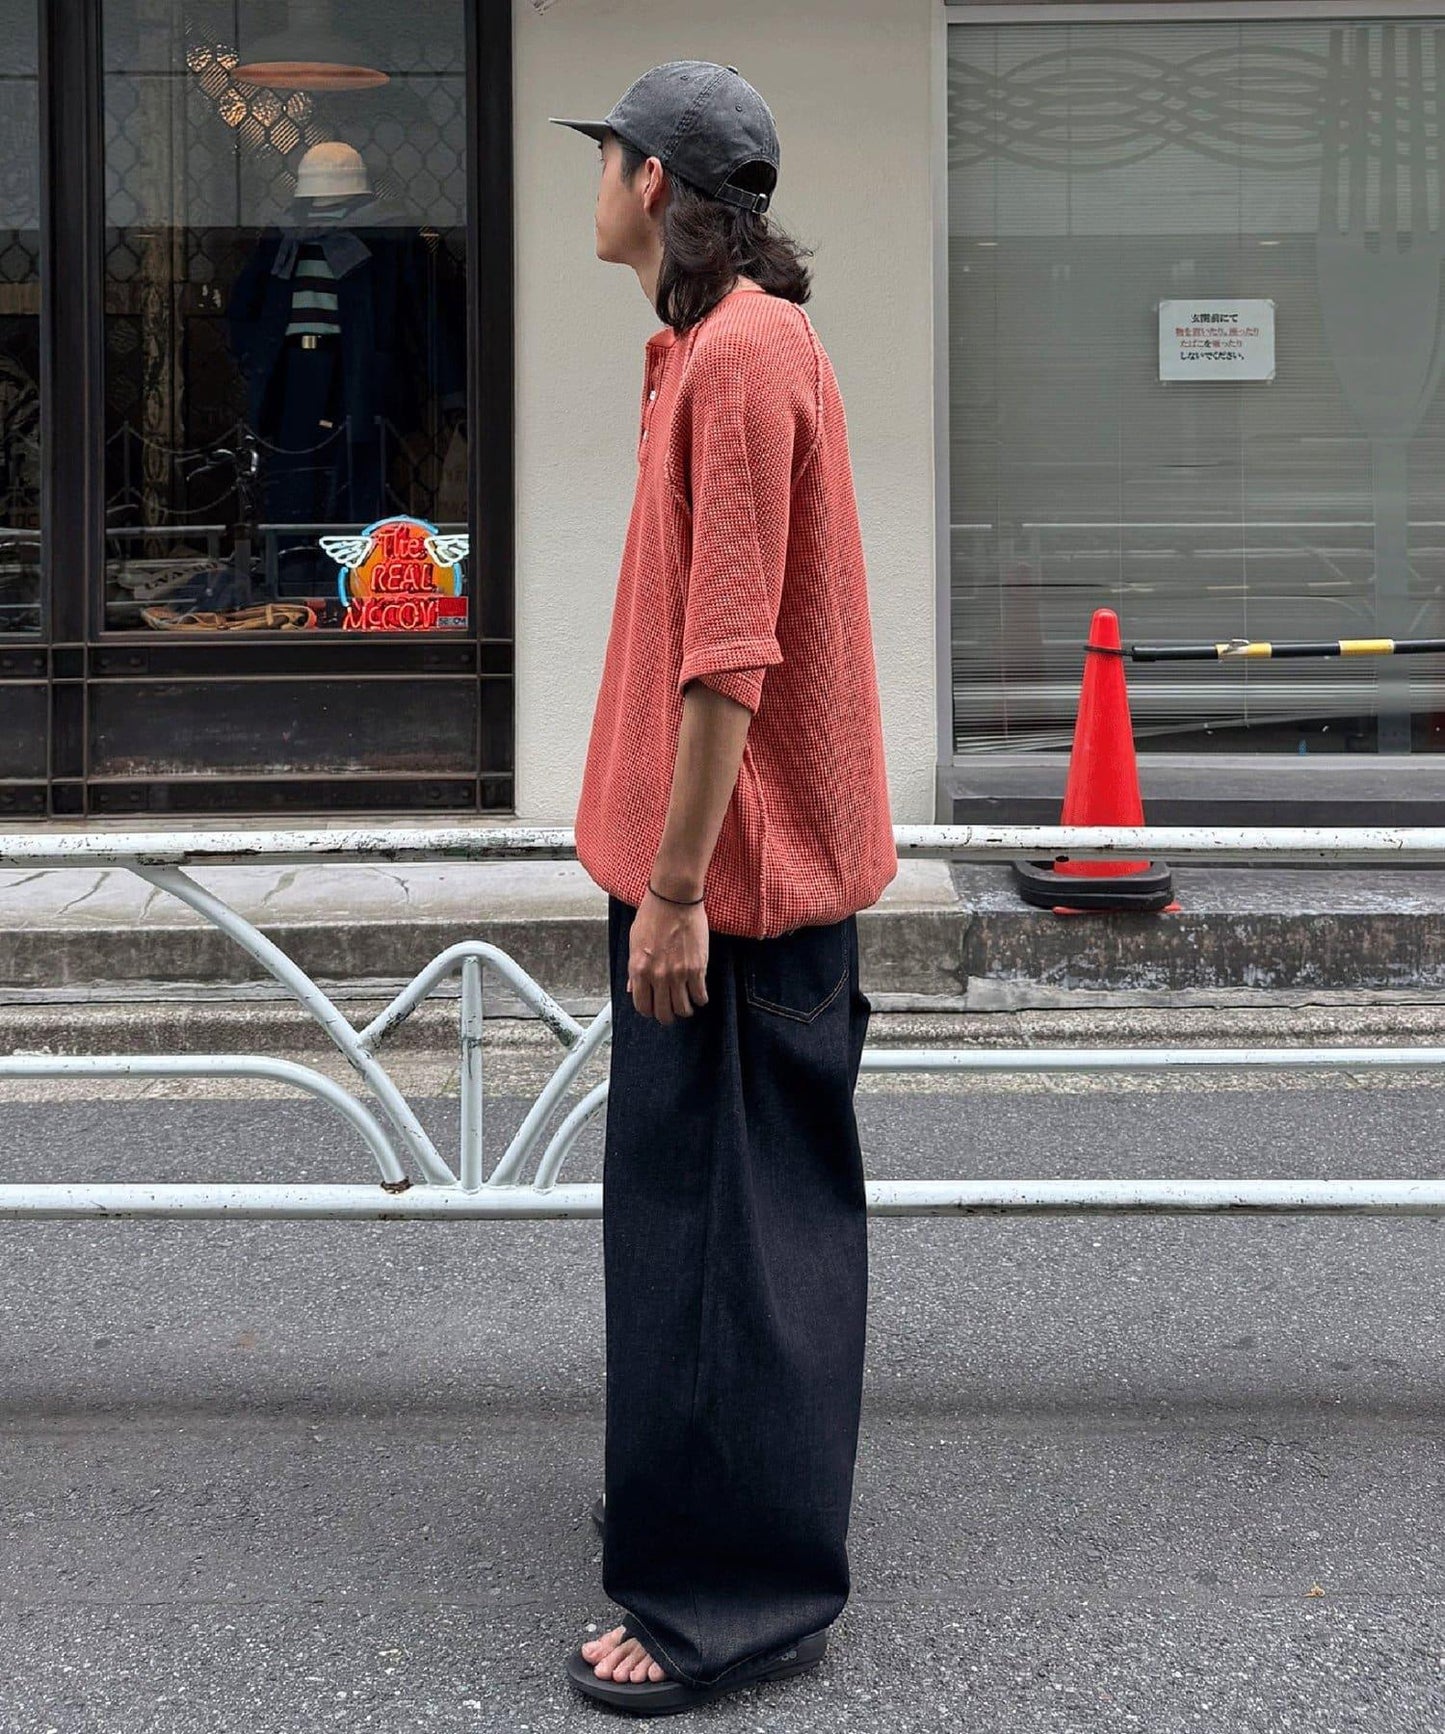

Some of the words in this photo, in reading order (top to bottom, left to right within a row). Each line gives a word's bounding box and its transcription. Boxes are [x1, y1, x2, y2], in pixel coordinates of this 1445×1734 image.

[1192, 313, 1238, 323] 玄関前にて
[379, 523, 423, 558] The
[372, 565, 432, 591] REAL
